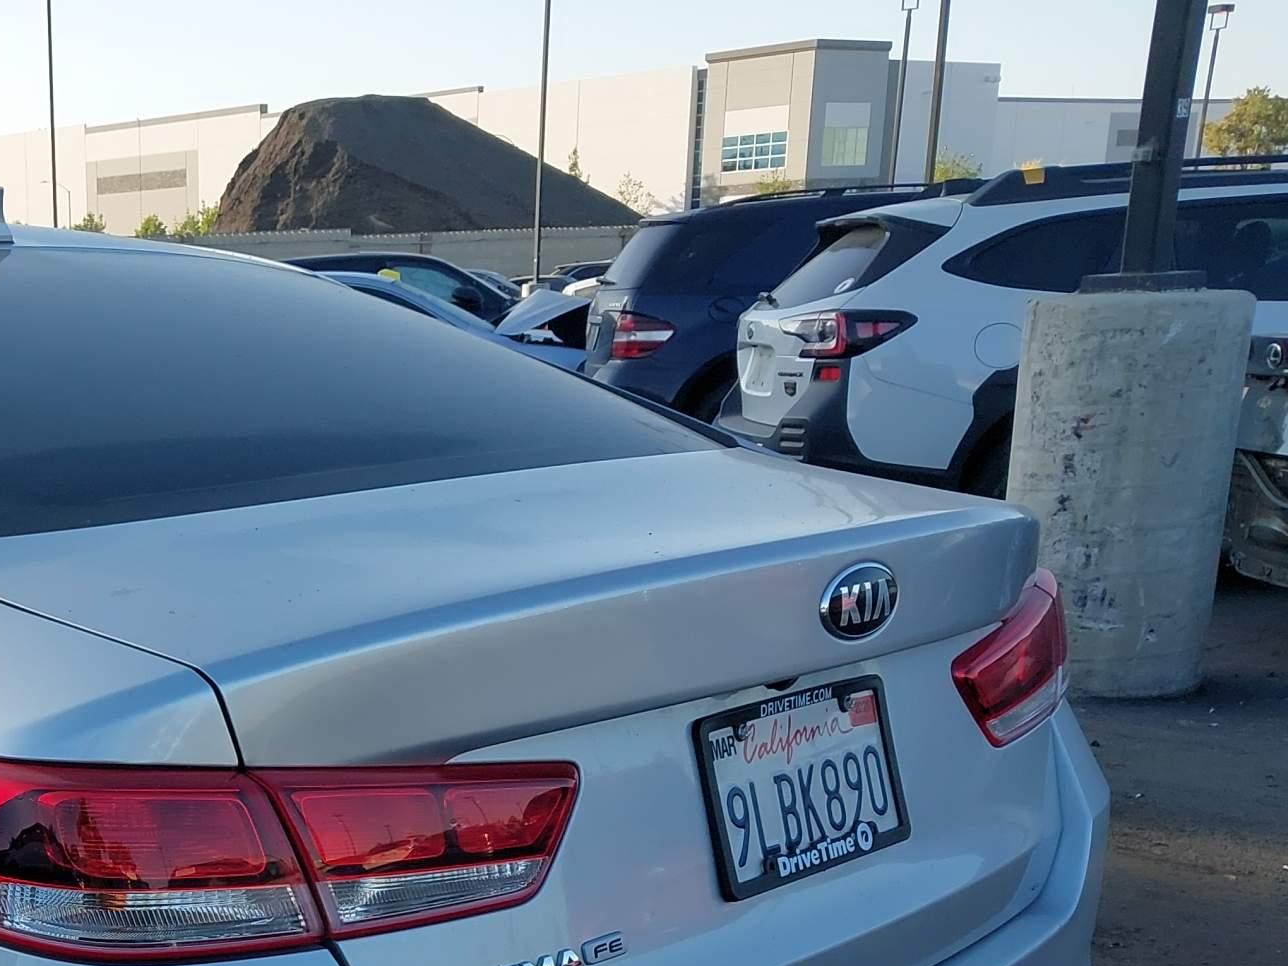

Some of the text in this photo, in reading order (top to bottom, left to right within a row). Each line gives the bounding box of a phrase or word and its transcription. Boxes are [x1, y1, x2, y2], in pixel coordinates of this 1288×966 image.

[839, 578, 891, 626] KIA
[760, 687, 833, 718] DRIVETIME.COM
[710, 735, 737, 761] MAR
[741, 714, 854, 764] California
[726, 745, 888, 868] 9LBK890
[593, 937, 624, 959] FE
